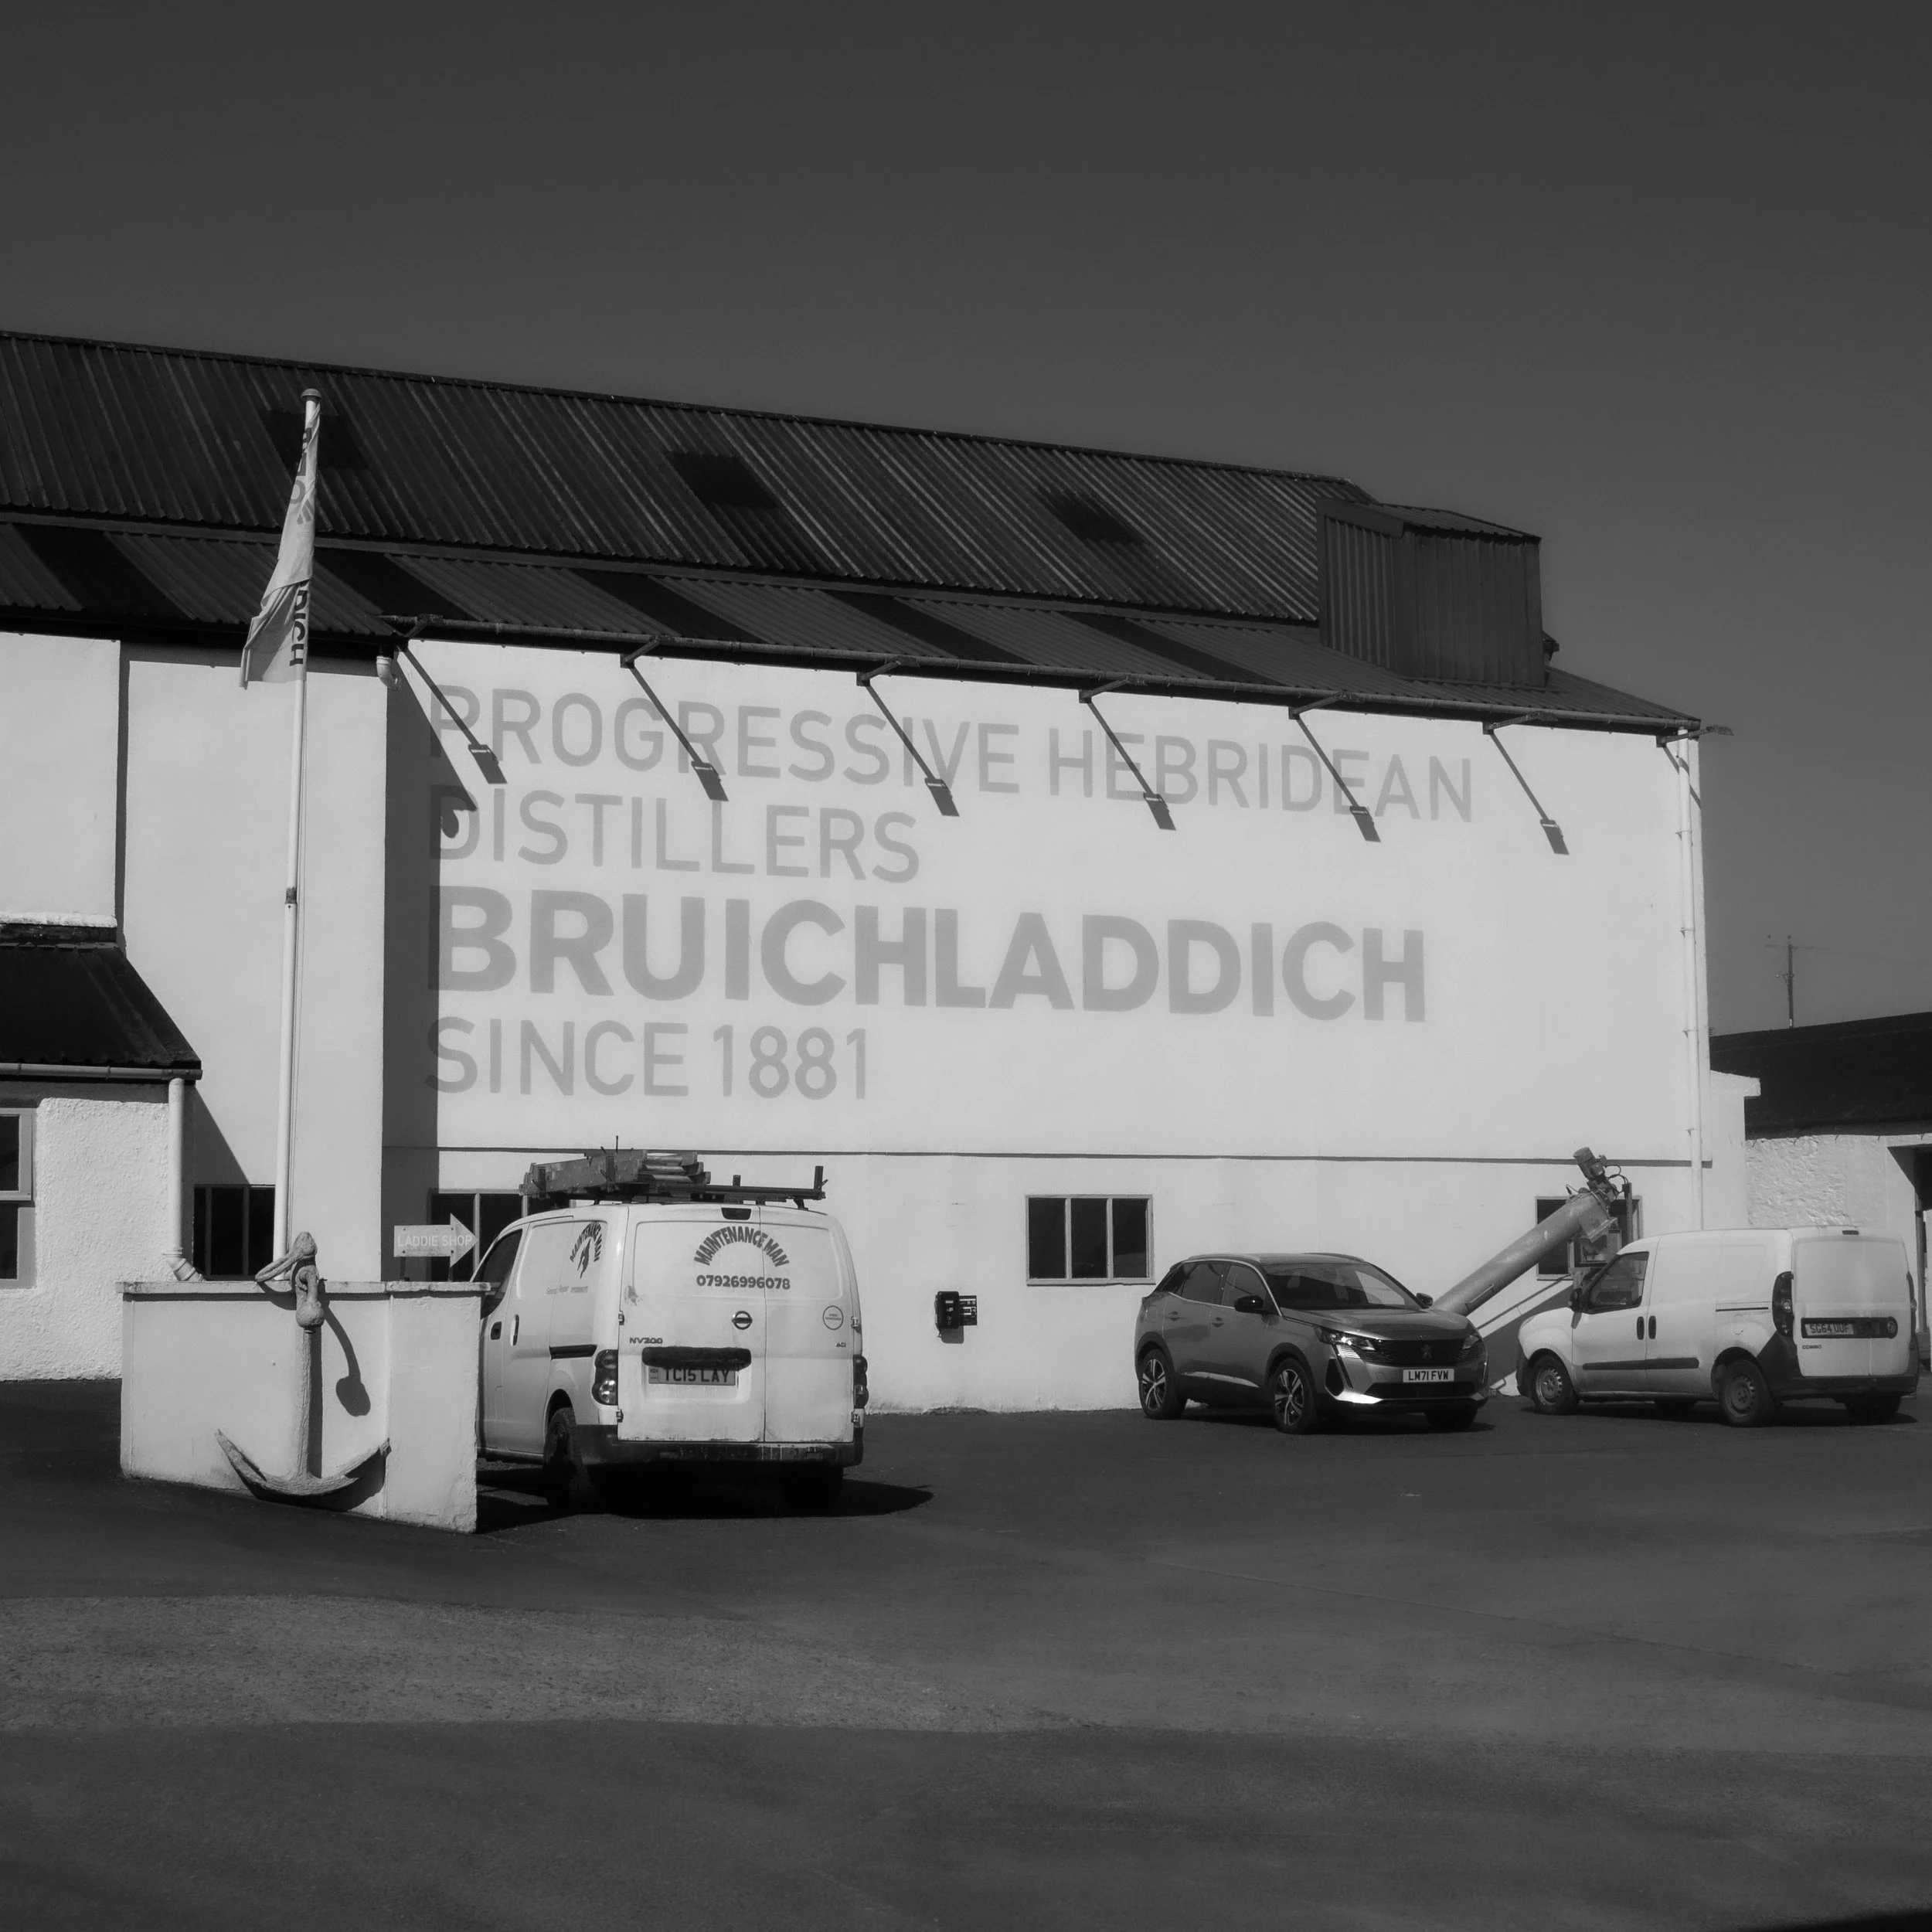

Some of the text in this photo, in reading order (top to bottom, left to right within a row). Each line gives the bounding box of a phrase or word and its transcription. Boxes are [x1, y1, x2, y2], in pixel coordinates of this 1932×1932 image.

[430, 685, 1471, 823] PROGRESSIVE HEBRIDEAN
[430, 784, 919, 883] DISTILLERS
[428, 885, 1425, 1022] BRUICHLADDICH
[425, 1017, 866, 1100] SINCE 1881
[397, 1235, 473, 1247] LADDIE SHOP
[694, 1226, 790, 1267] MAINTENANCE MAN
[696, 1274, 791, 1290] 07926996078
[701, 1368, 730, 1383] LAY
[1408, 1370, 1448, 1381] LM71 FVW
